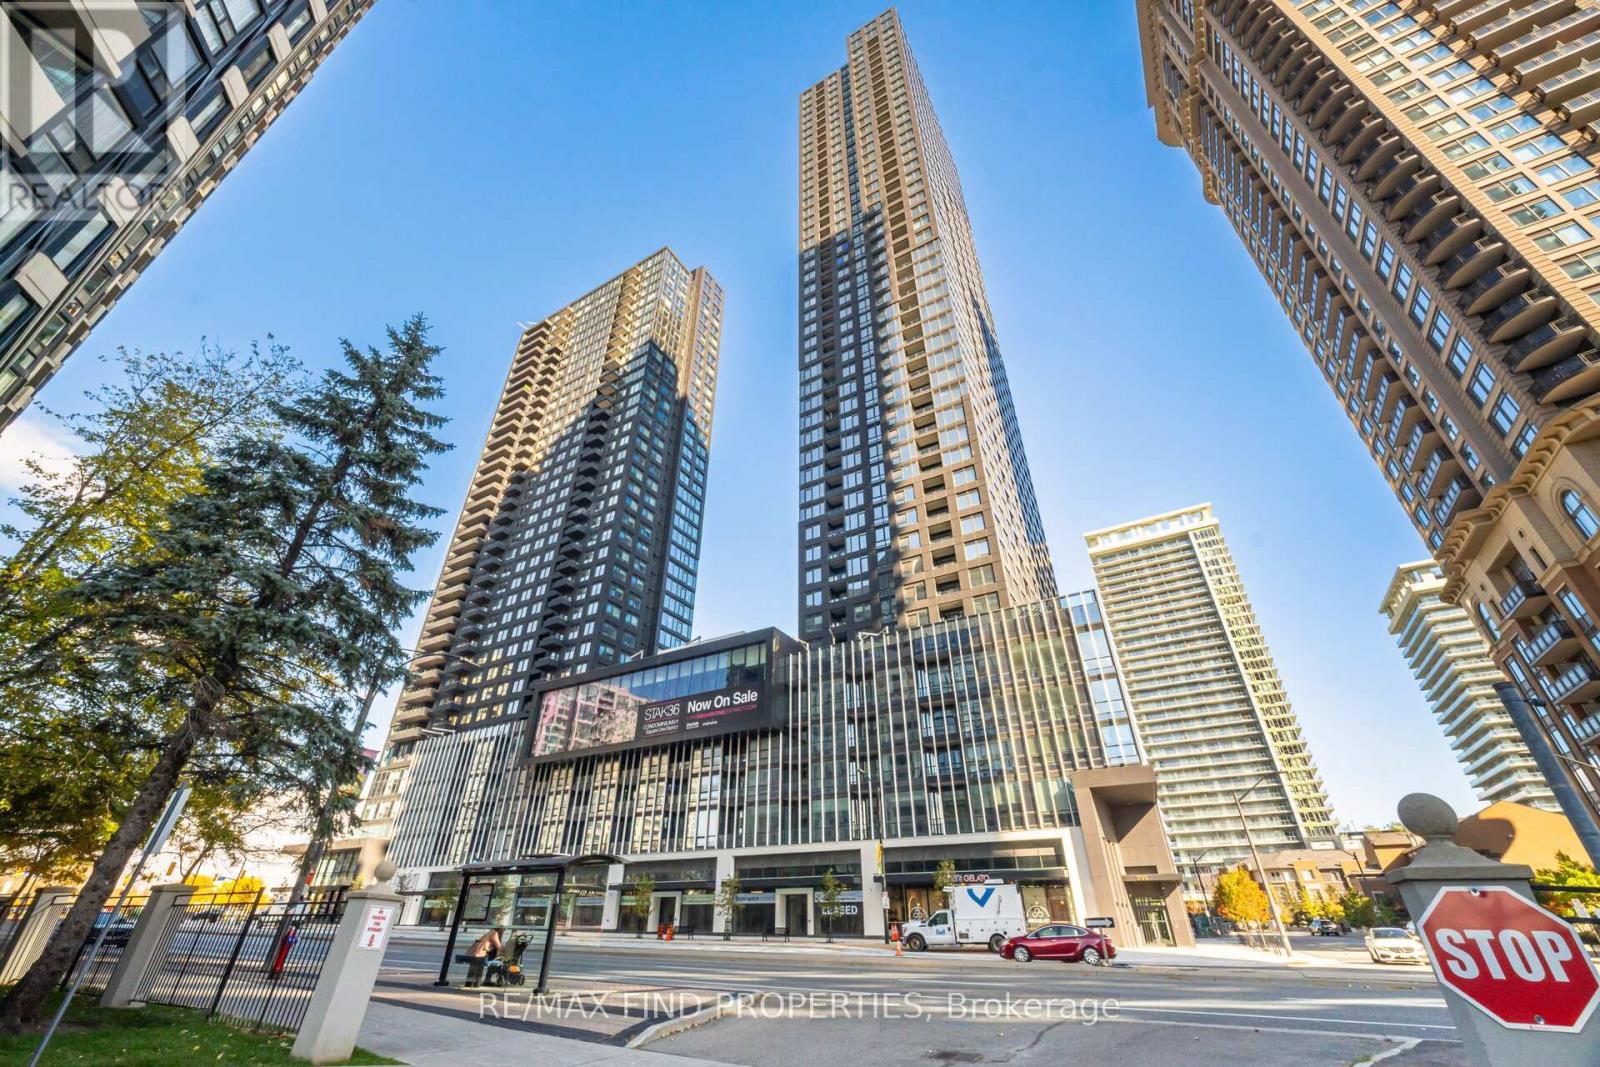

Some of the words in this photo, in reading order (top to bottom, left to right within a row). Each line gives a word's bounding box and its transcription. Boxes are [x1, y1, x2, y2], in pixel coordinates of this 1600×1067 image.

[644, 703, 680, 721] STAK36
[687, 700, 711, 714] Now
[714, 695, 730, 708] On
[733, 689, 758, 705] Sale
[963, 874, 990, 882] GELATO
[1435, 928, 1573, 983] STOP
